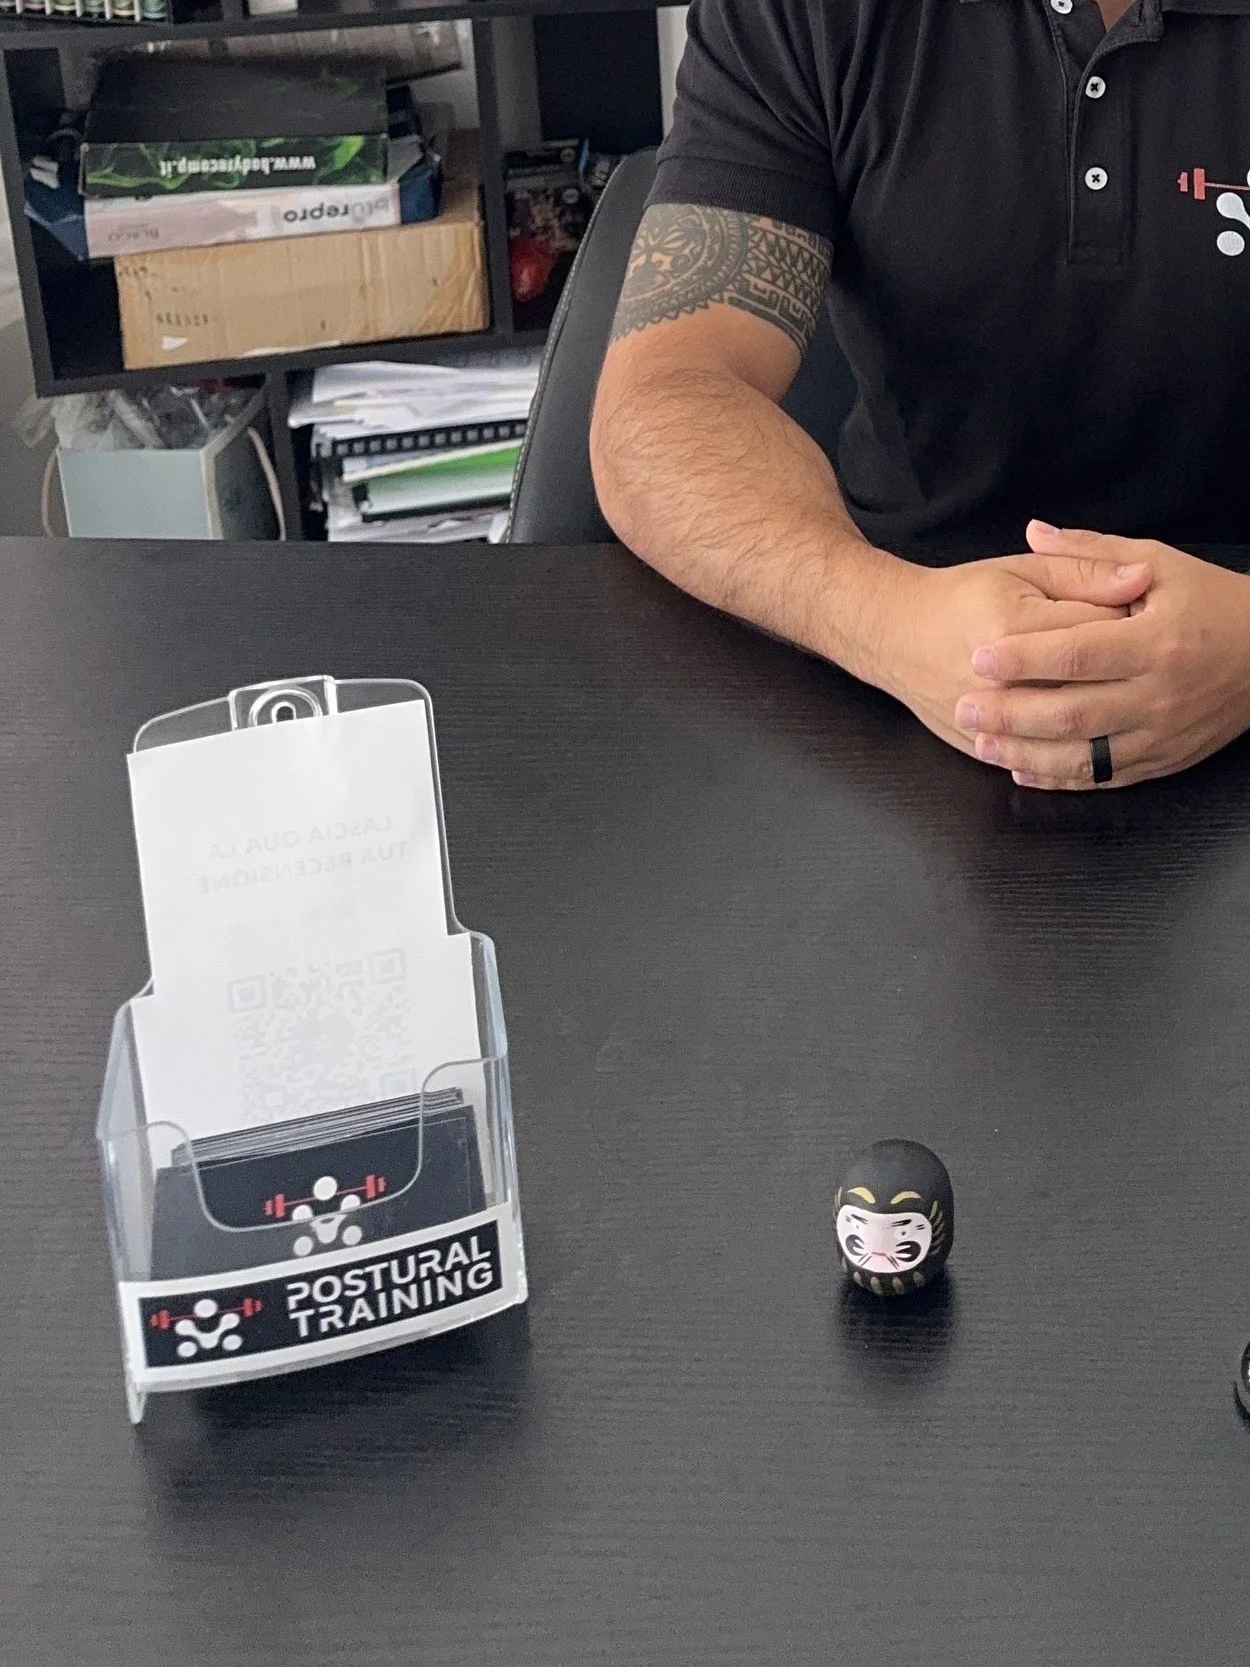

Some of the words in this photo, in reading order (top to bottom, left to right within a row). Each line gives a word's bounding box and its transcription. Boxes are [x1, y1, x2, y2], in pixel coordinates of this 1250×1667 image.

[159, 153, 316, 178] www.bodyrecomp.it
[287, 1235, 491, 1310] POSTURAL
[289, 1261, 494, 1338] TRAINING
